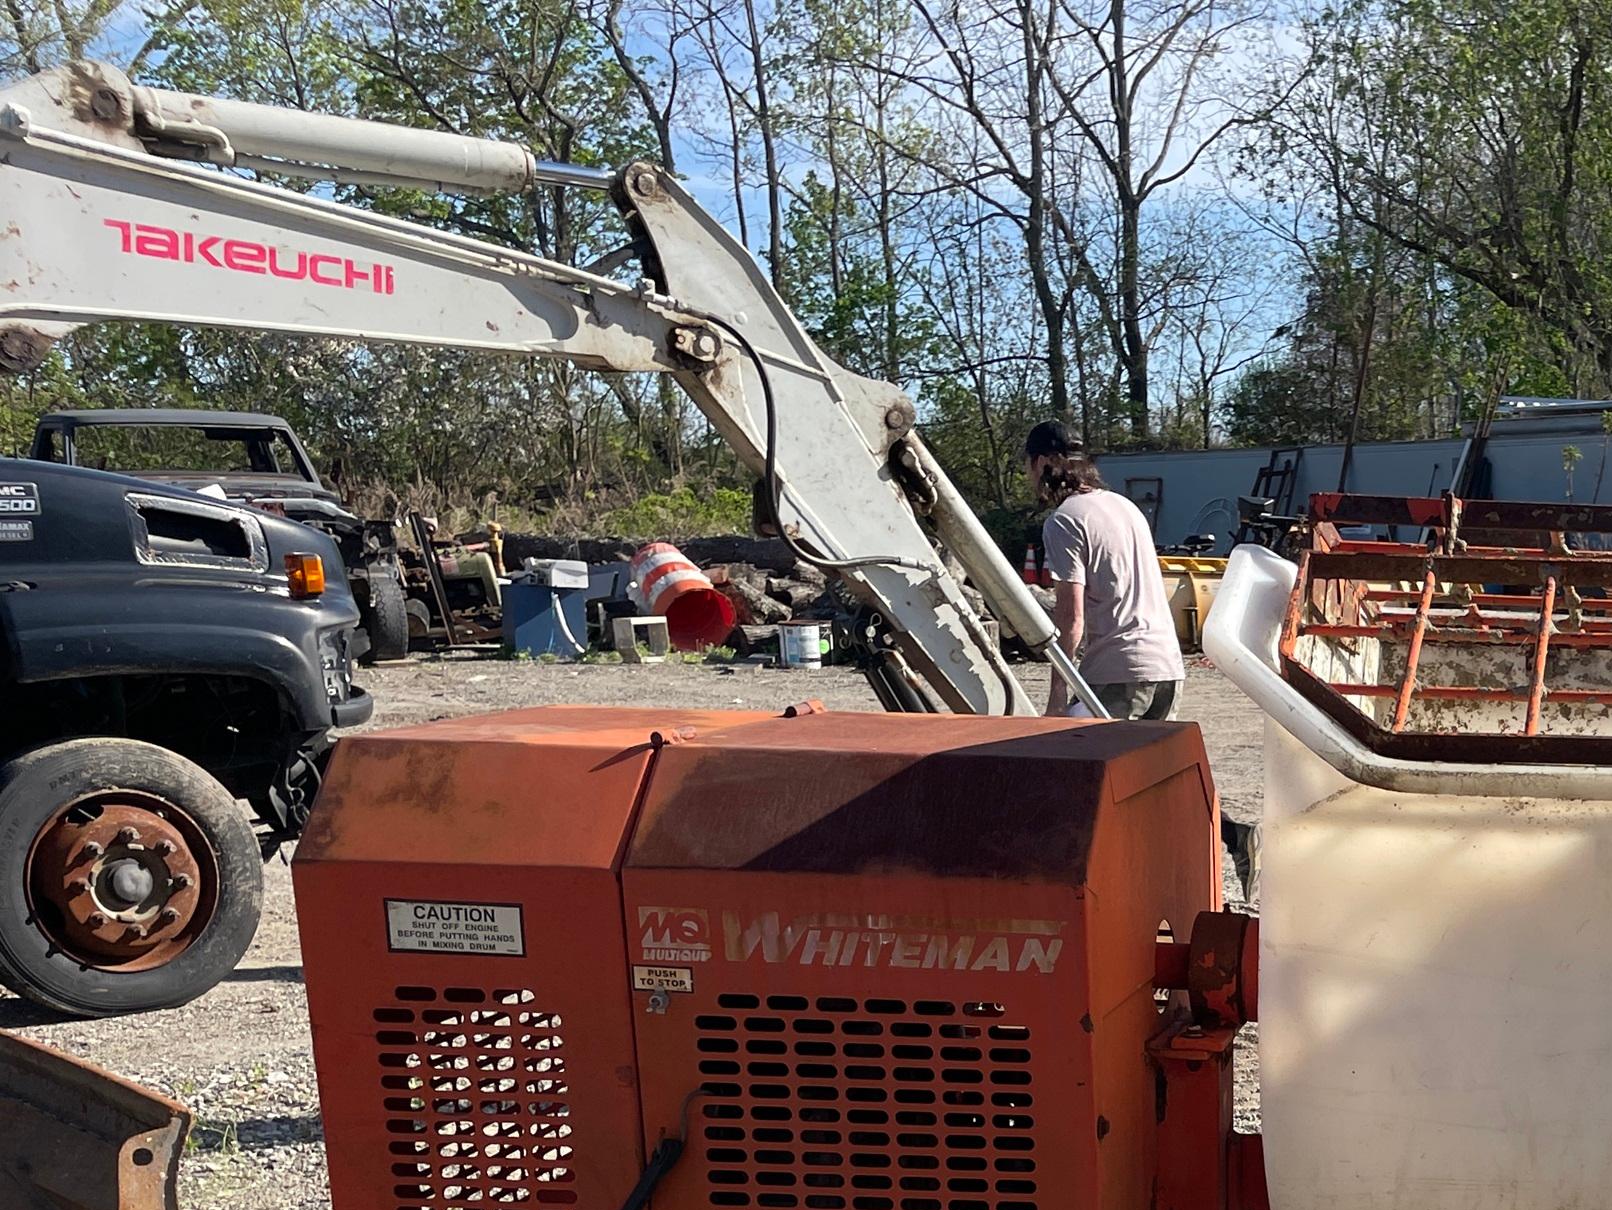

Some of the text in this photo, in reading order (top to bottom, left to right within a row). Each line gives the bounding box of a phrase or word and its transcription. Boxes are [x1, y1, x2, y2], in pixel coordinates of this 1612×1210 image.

[414, 905, 496, 923] CAUTION
[412, 921, 499, 933] SHUT OFF ENGINE
[398, 930, 515, 943] BEFORE PUTTING HANDS
[418, 940, 428, 948] IN
[433, 941, 465, 950] MIXING
[469, 943, 497, 951] DRUM
[721, 911, 1064, 975] WHITEMAN
[647, 969, 677, 977] PUSH
[640, 977, 686, 988] TO STOP
